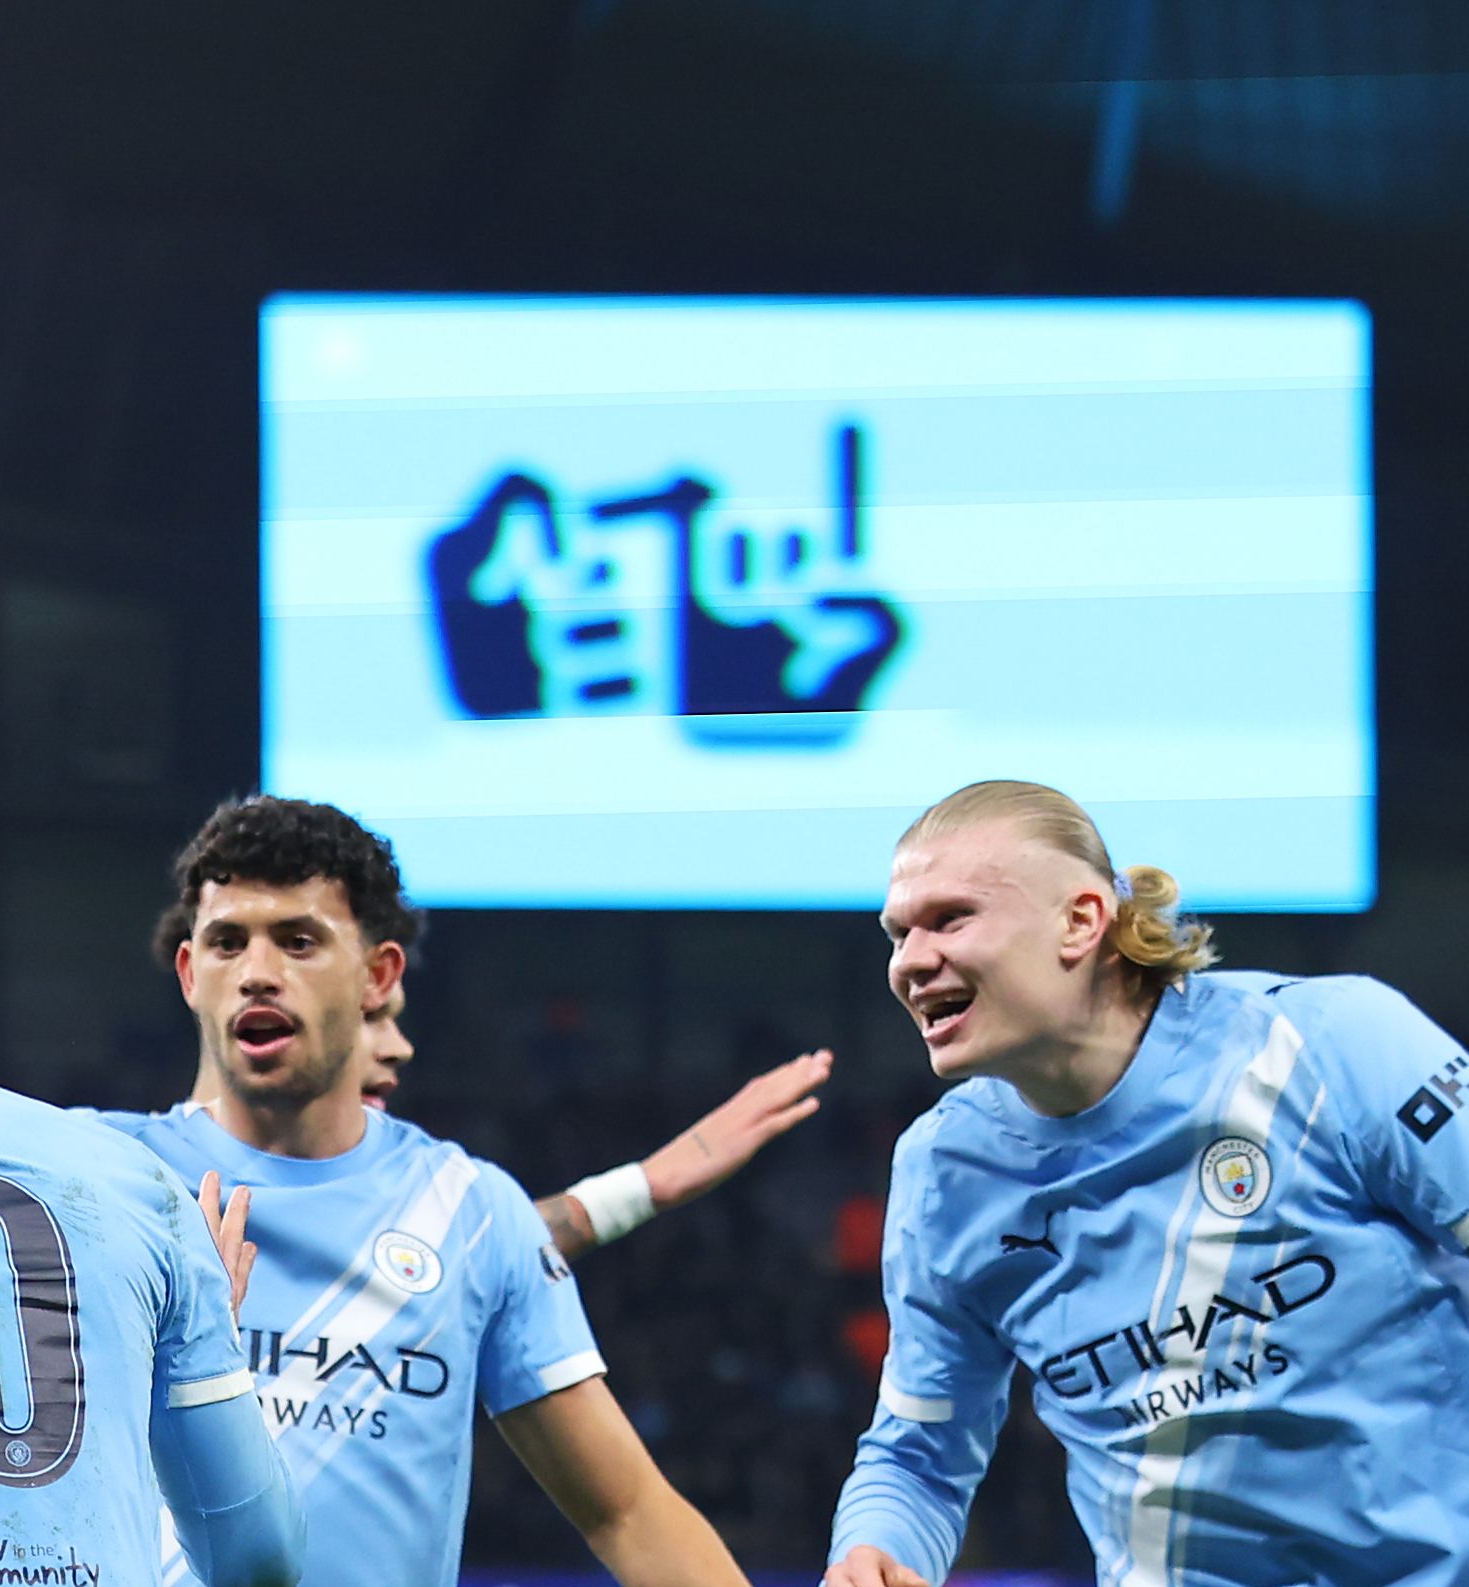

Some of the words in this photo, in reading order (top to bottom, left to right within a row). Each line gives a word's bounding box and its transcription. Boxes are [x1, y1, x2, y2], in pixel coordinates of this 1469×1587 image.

[1041, 1254, 1336, 1398] ETIHAD
[238, 1327, 449, 1399] IHAD
[30, 1543, 54, 1557] the
